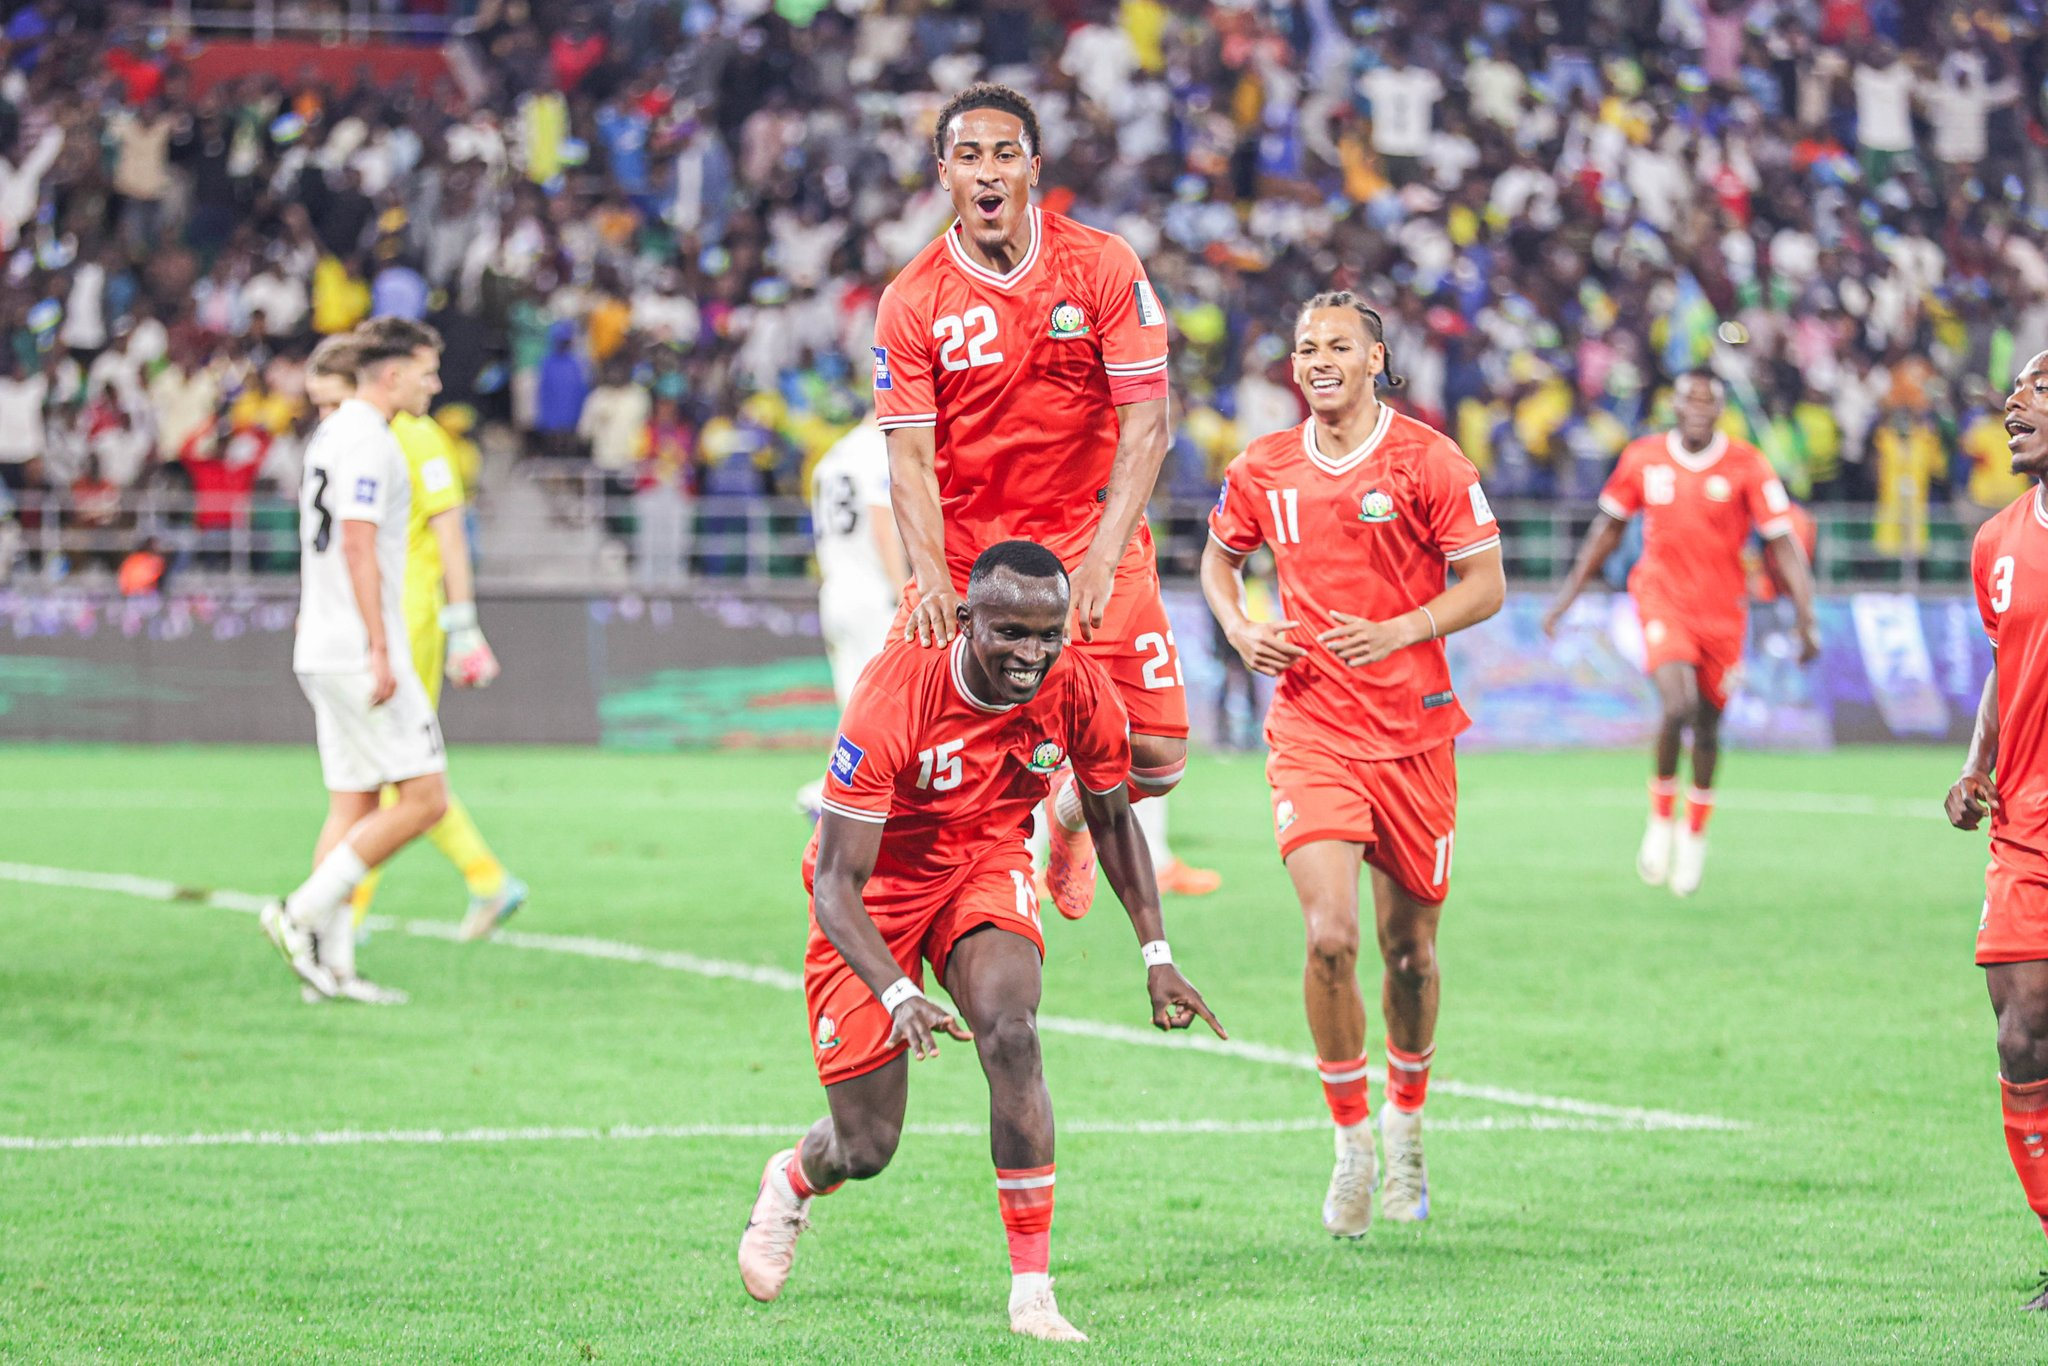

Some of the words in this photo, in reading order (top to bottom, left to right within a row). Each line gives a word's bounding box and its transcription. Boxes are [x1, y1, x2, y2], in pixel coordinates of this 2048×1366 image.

[932, 305, 1004, 372] 22
[1265, 488, 1301, 544] 11
[1991, 555, 2015, 614] 3
[915, 738, 965, 791] 15
